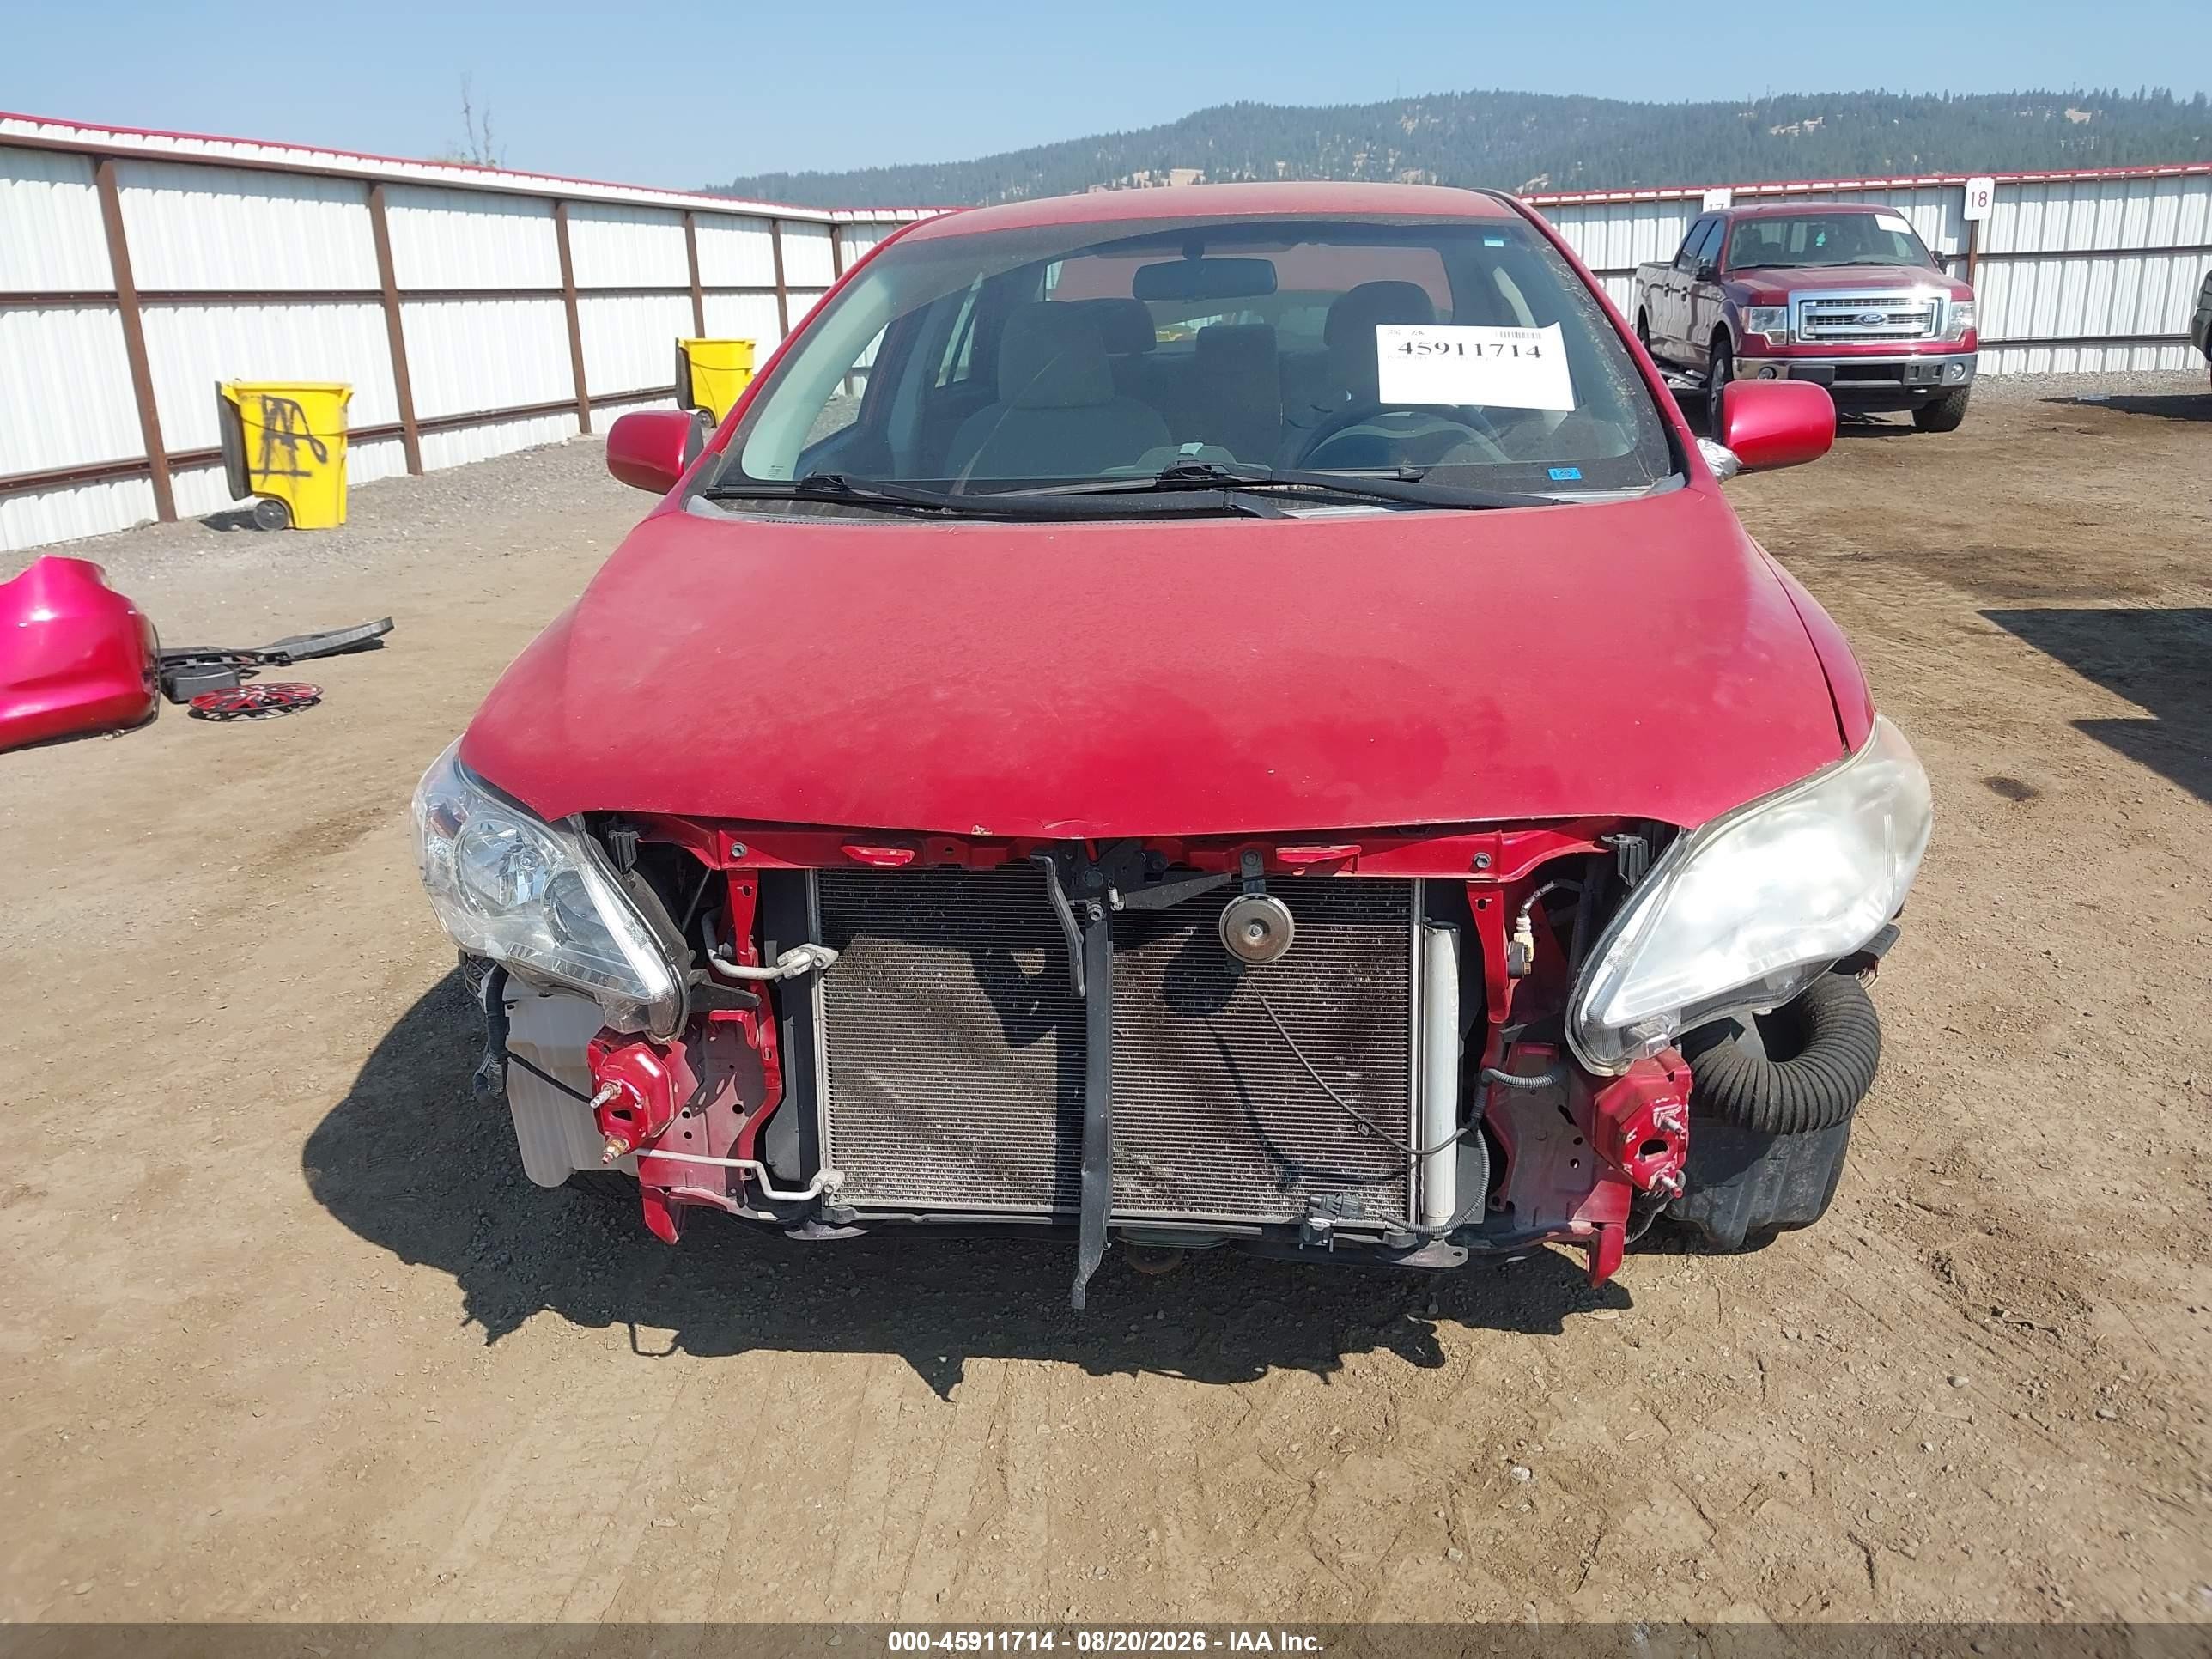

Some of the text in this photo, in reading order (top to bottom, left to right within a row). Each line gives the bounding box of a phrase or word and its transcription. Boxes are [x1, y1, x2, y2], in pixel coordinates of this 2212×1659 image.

[1971, 191, 1988, 209] 18
[1863, 313, 1883, 323] Ford
[1397, 341, 1543, 359] 45911714
